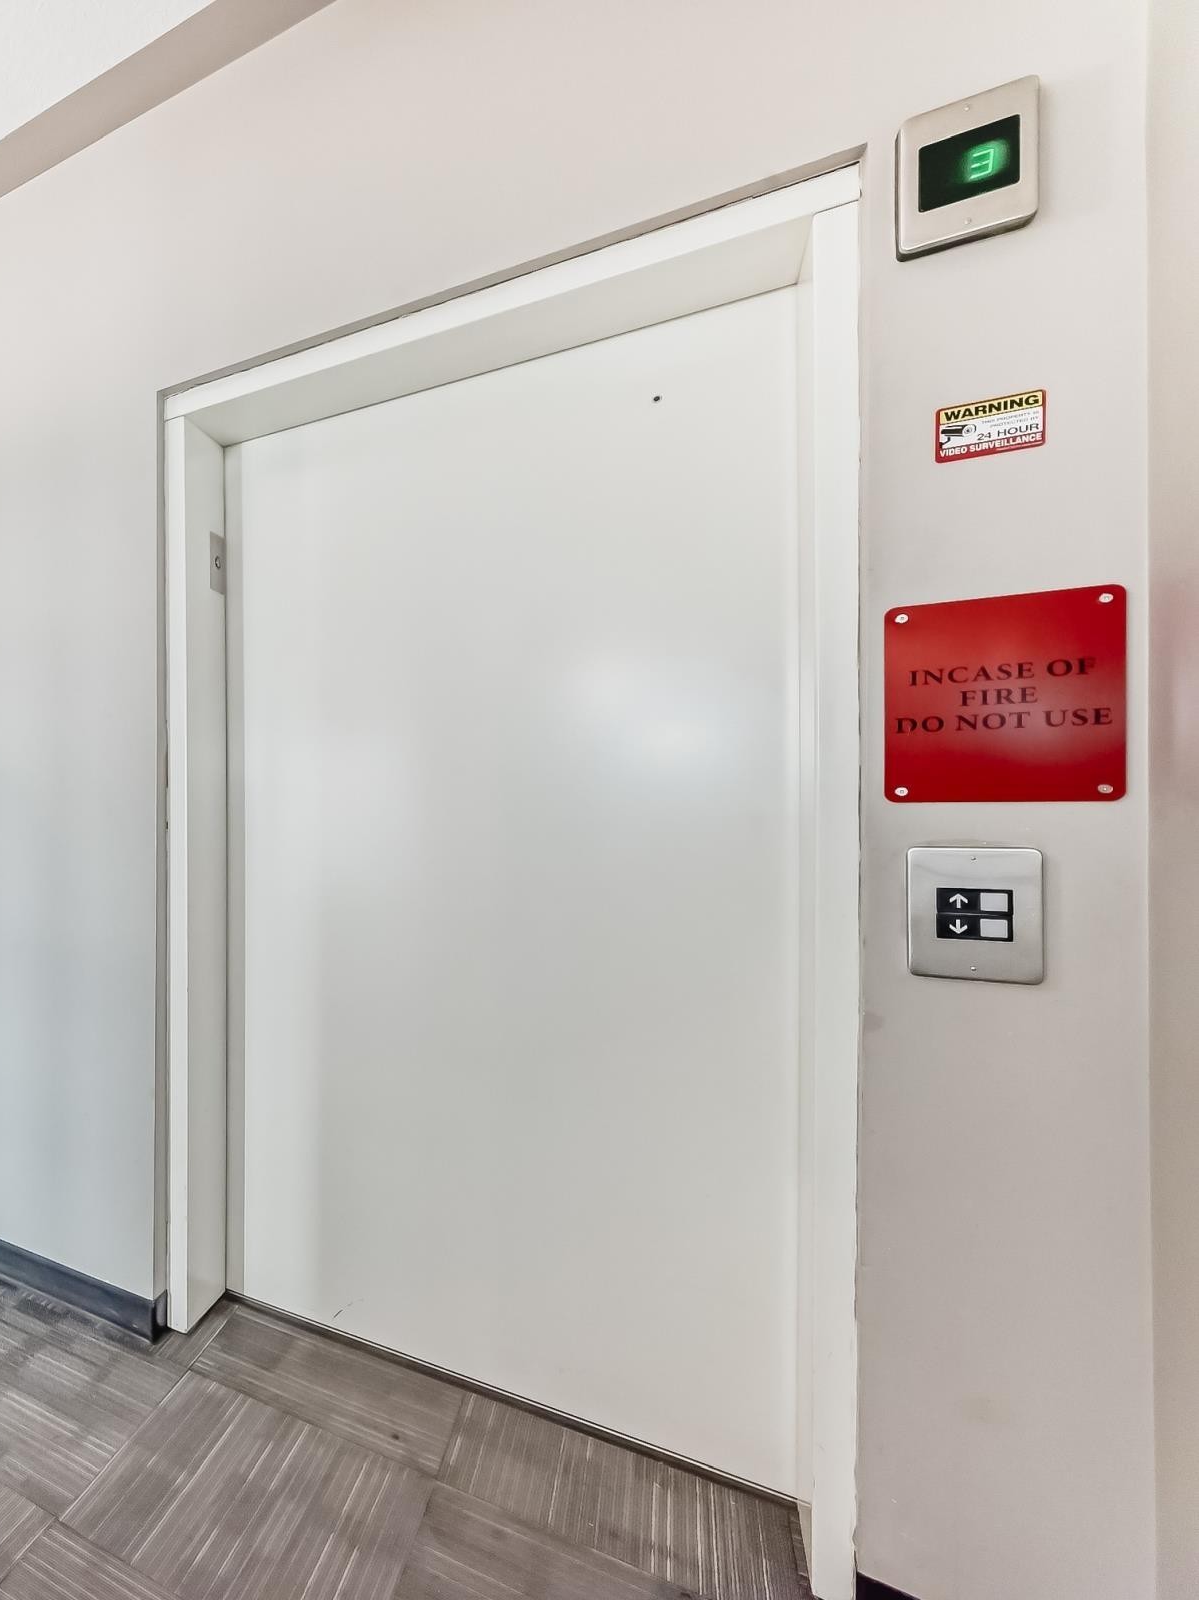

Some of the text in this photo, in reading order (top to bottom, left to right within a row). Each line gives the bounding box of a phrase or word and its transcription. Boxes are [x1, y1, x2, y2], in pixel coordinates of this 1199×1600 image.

[969, 148, 995, 180] 3
[944, 395, 1040, 422] WARNING
[939, 432, 1043, 458] VIDEO SURVEILLANCE
[977, 423, 1040, 441] 24 HOUR
[909, 657, 1096, 686] INCASE OF
[959, 686, 1039, 707] FIRE
[895, 707, 1113, 734] DO NOT USE
